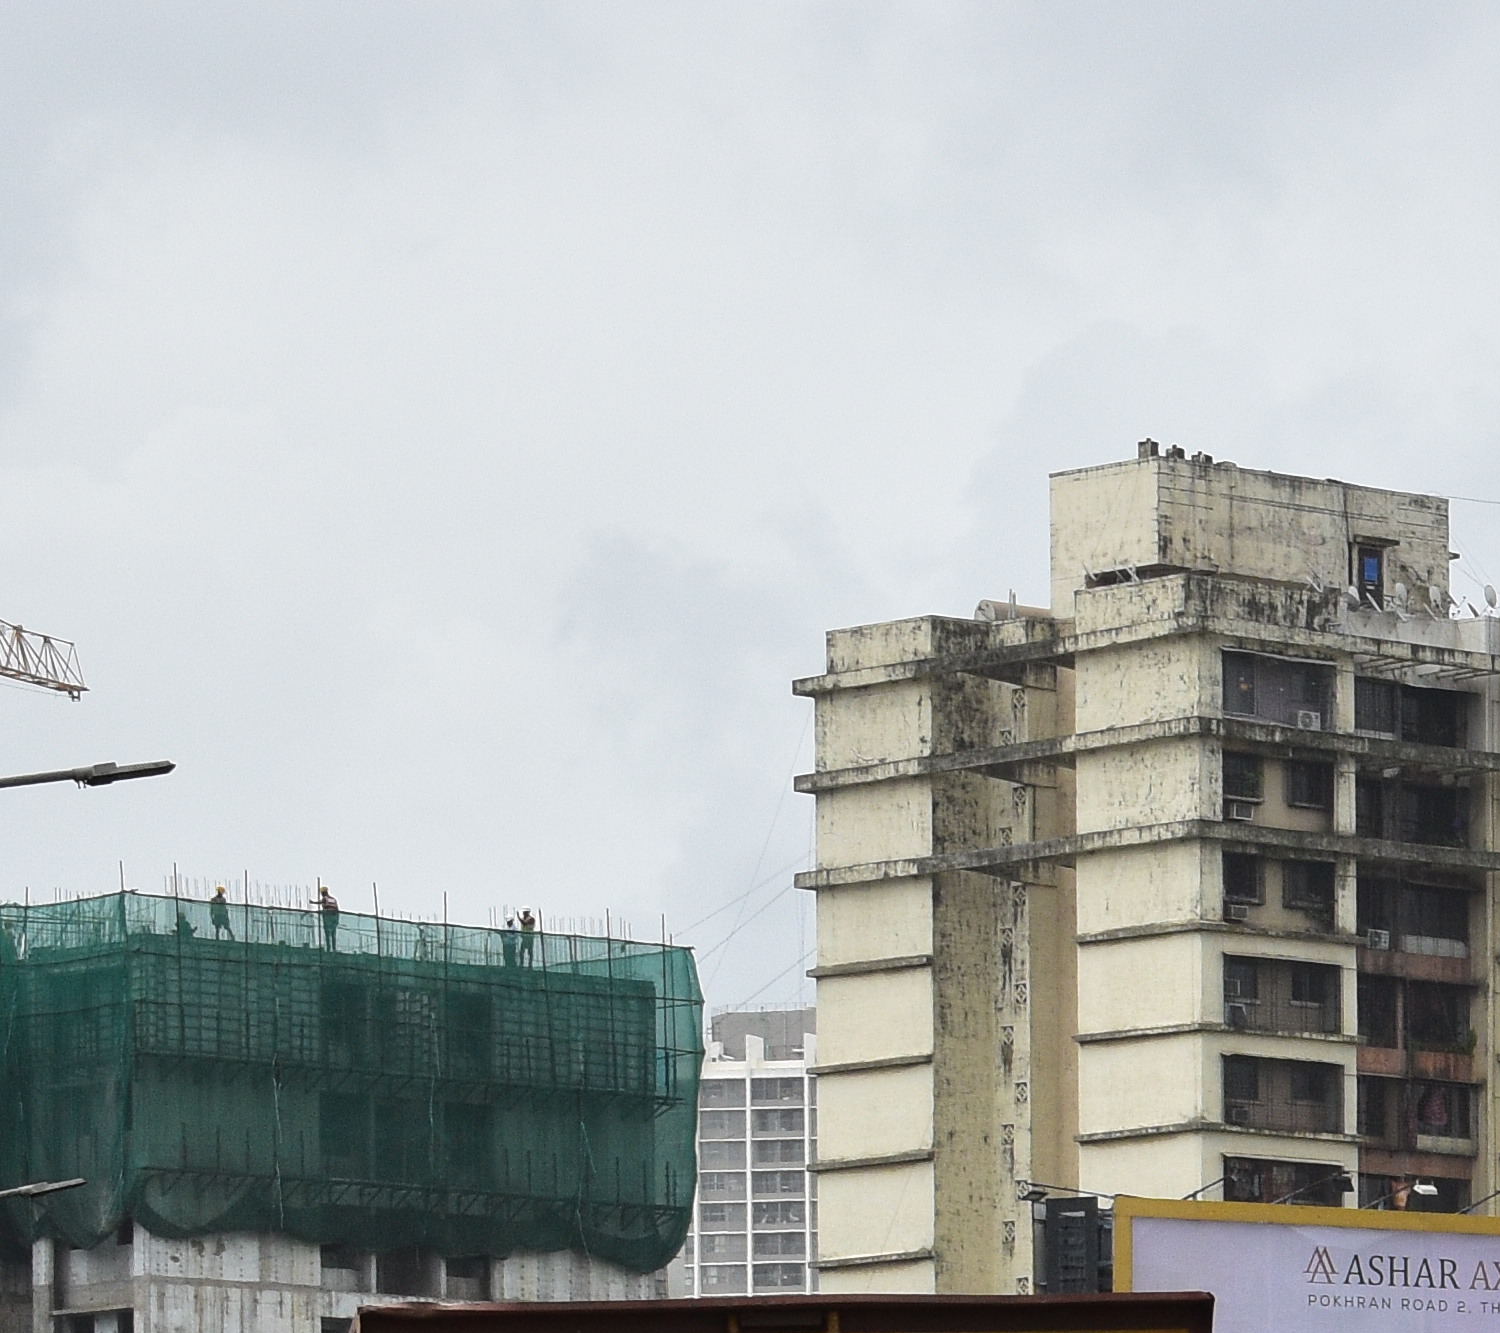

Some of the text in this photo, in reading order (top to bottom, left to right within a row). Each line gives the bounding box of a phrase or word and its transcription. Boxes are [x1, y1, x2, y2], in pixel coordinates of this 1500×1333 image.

[1344, 1255, 1460, 1290] ASHAR
[1309, 1294, 1395, 1312] POKHRAN
[1402, 1297, 1450, 1313] ROAD
